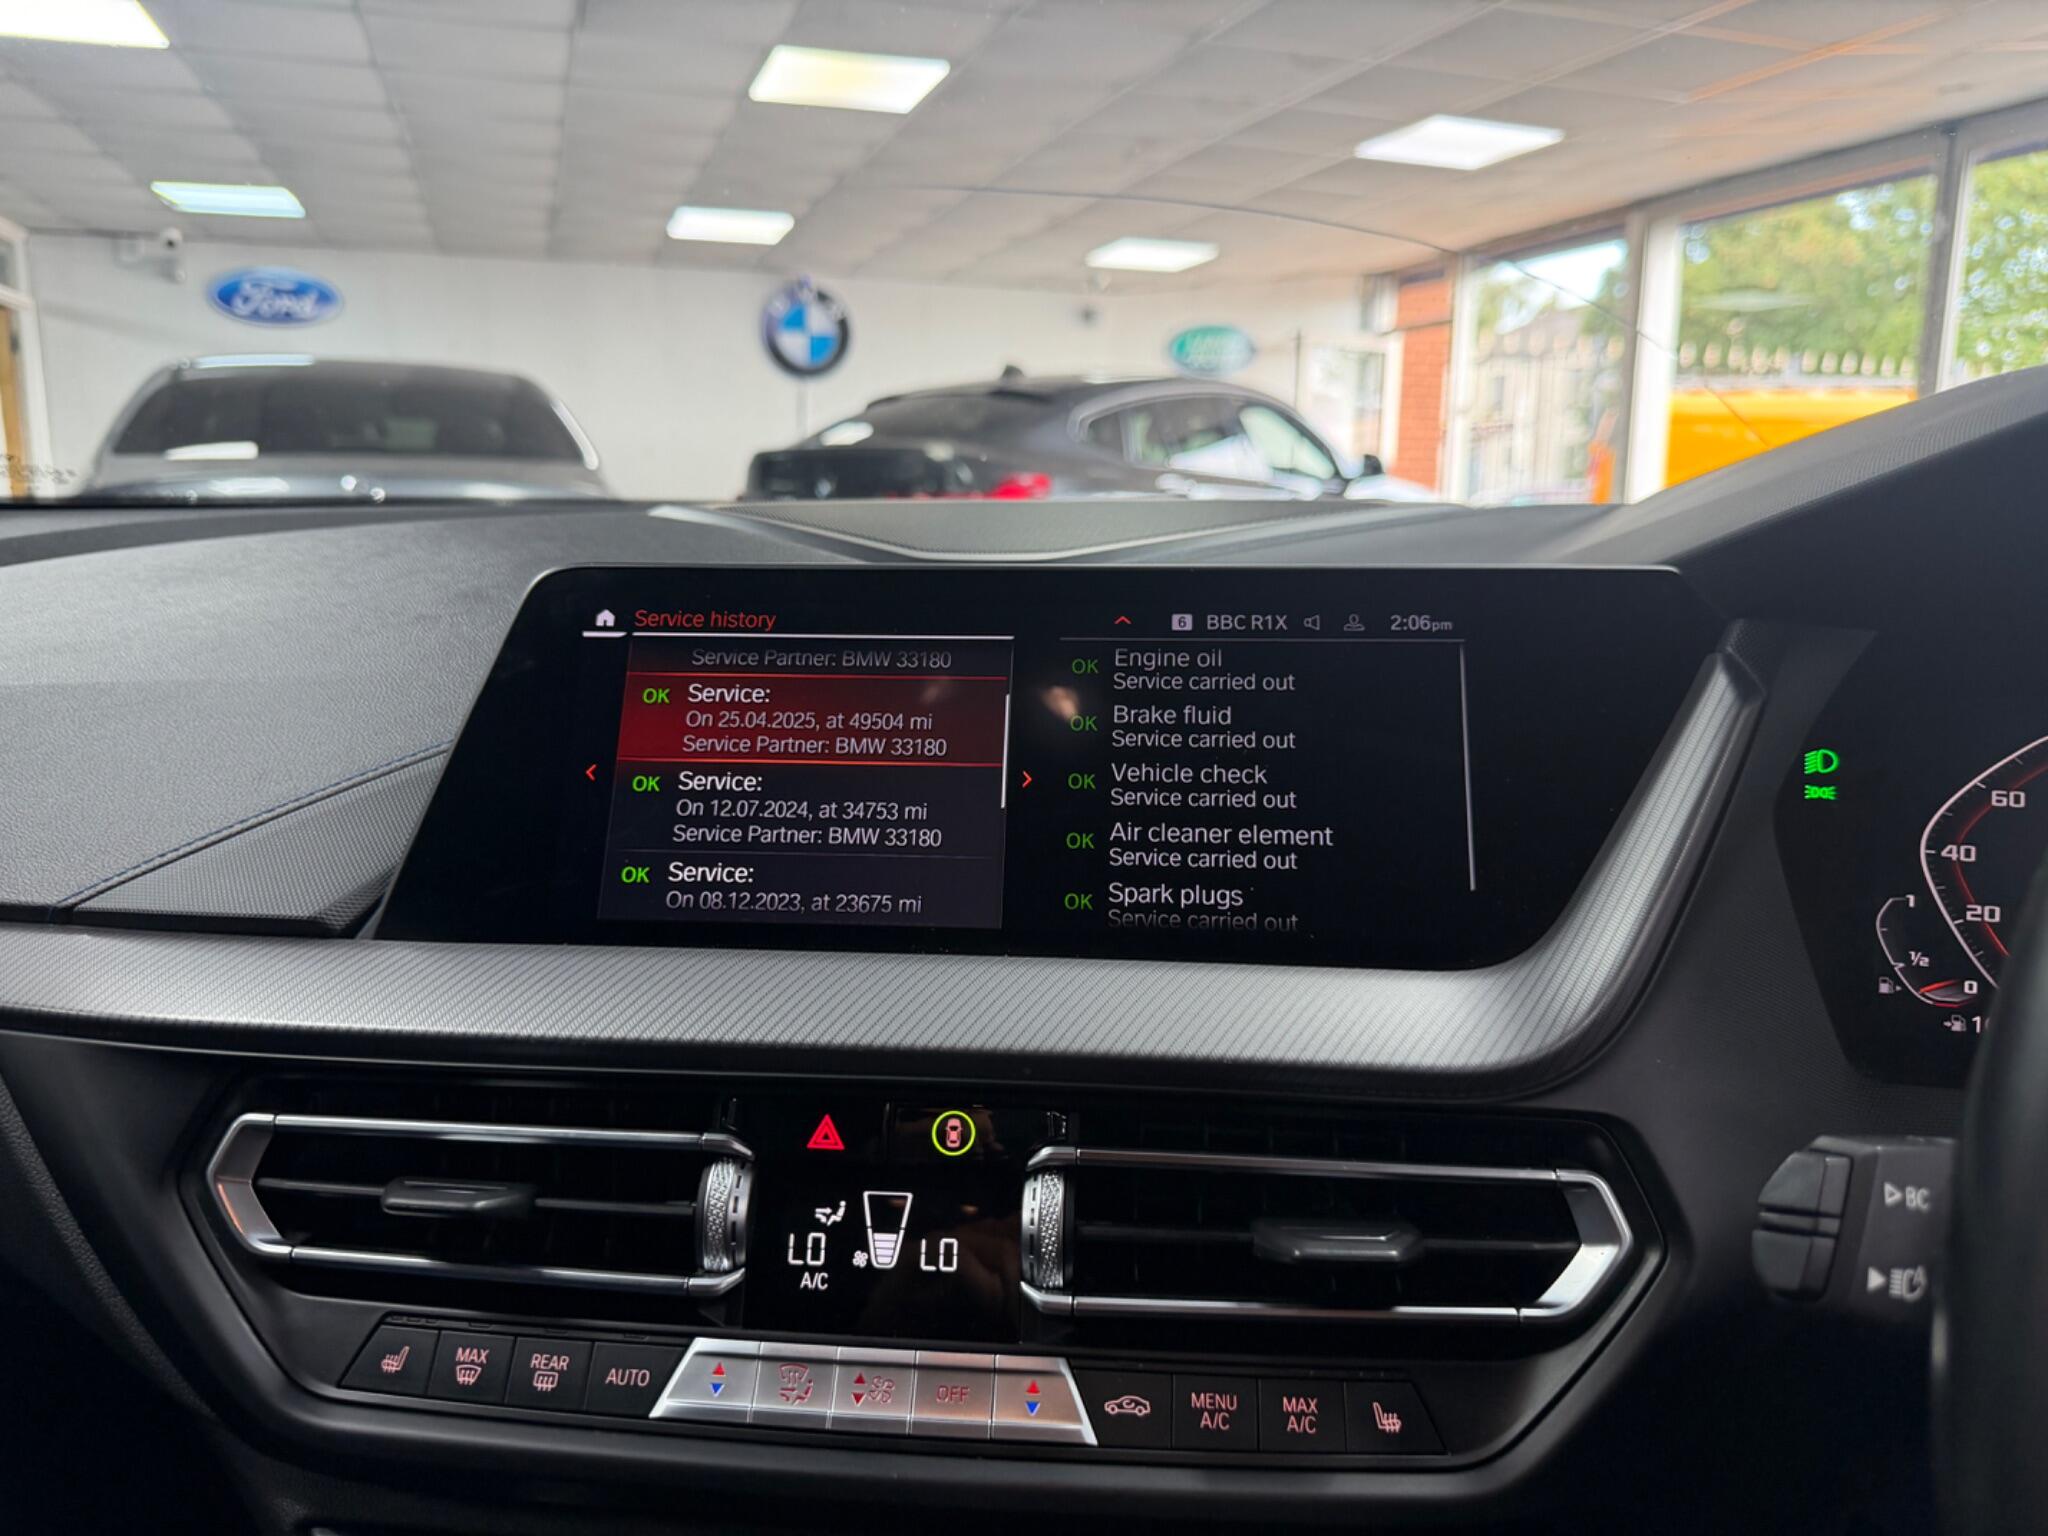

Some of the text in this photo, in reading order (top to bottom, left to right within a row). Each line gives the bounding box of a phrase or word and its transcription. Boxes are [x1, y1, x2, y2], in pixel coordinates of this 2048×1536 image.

[231, 281, 319, 318] Ford
[634, 610, 776, 631] Service history
[1177, 615, 1288, 630] 6 BBC R1X
[1390, 615, 1453, 632] 2:06pm
[692, 650, 952, 668] Service Partner: BMW 33180
[1072, 660, 1098, 673] OK
[1114, 649, 1222, 671] Engine oil
[1113, 673, 1295, 691] Service carried out
[643, 688, 670, 703] OK
[688, 685, 770, 703] Service:
[686, 712, 932, 731] On 25.04.2025, at 49504 mi
[1070, 716, 1097, 731] OK
[1113, 706, 1232, 724] Brake fluid
[683, 736, 947, 756] Service Partner: BMW 33180
[1112, 731, 1296, 749] Service carried out
[678, 772, 762, 791] Service:
[1068, 774, 1095, 789] OK
[1112, 763, 1268, 784] Vehicle check
[633, 776, 660, 792] OK
[1110, 789, 1297, 808] Service carried out
[1991, 791, 2025, 808] 60
[676, 800, 927, 820] On 12.07.2024, at 34753 mi
[673, 826, 942, 846] Service Partner: BMW 33180
[1066, 833, 1094, 848] OK
[1110, 823, 1333, 846] Air cleaner element
[1109, 849, 1298, 869] Service carried out
[1941, 845, 1976, 862] 40
[622, 867, 650, 883] OK
[668, 863, 754, 882] Service:
[666, 892, 922, 913] On 08.12.2023, at 23675 mi
[1065, 894, 1093, 910] OK
[1108, 883, 1244, 910] Spark plugs
[1906, 894, 1915, 907] 1
[1108, 909, 1299, 932] Service carried out
[1966, 905, 2000, 922] 20
[1964, 981, 1978, 994] 0
[1972, 1017, 1989, 1034] 1
[1906, 1186, 1930, 1210] BC
[788, 1233, 826, 1265] LO
[921, 1239, 958, 1272] LO
[801, 1272, 828, 1290] A/C
[456, 1347, 489, 1363] MAX
[531, 1353, 569, 1370] REAR
[605, 1368, 650, 1386] AUTO
[936, 1385, 970, 1403] OFF
[1191, 1392, 1238, 1412] MENU
[1283, 1396, 1318, 1415] MAX
[1200, 1411, 1230, 1431] A/C
[1286, 1414, 1317, 1434] A/C
